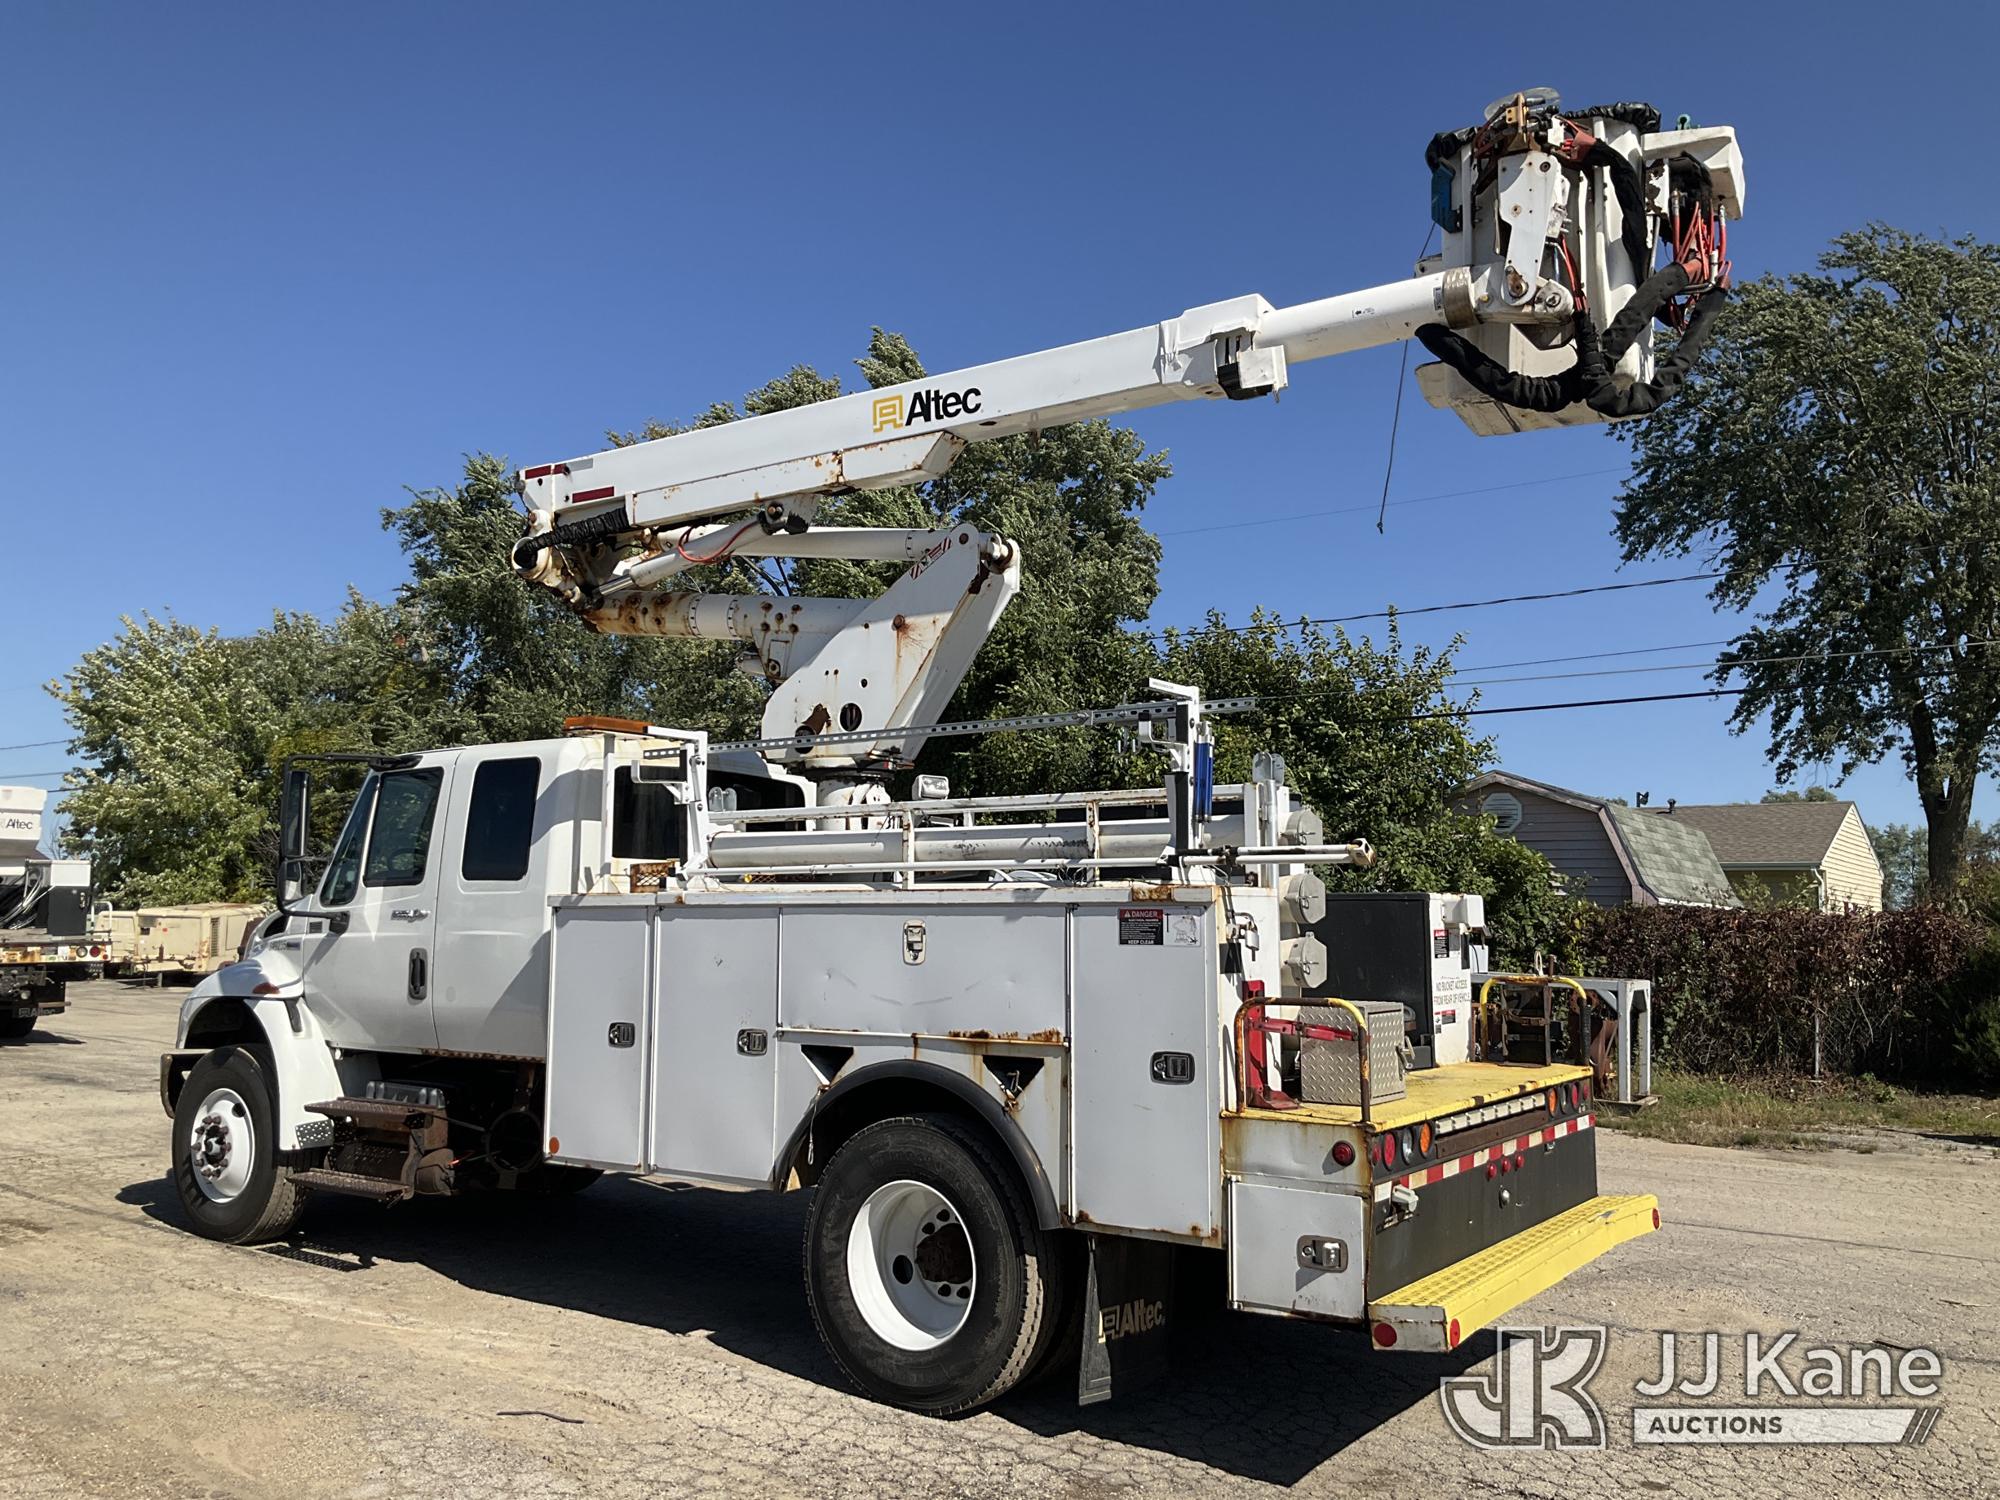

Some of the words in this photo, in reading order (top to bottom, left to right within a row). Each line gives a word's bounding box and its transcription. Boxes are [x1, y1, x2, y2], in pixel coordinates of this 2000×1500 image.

[905, 387, 982, 426] Altec
[6, 818, 33, 830] Altec
[1131, 910, 1158, 918] DANGER
[1119, 1298, 1164, 1338] Altec
